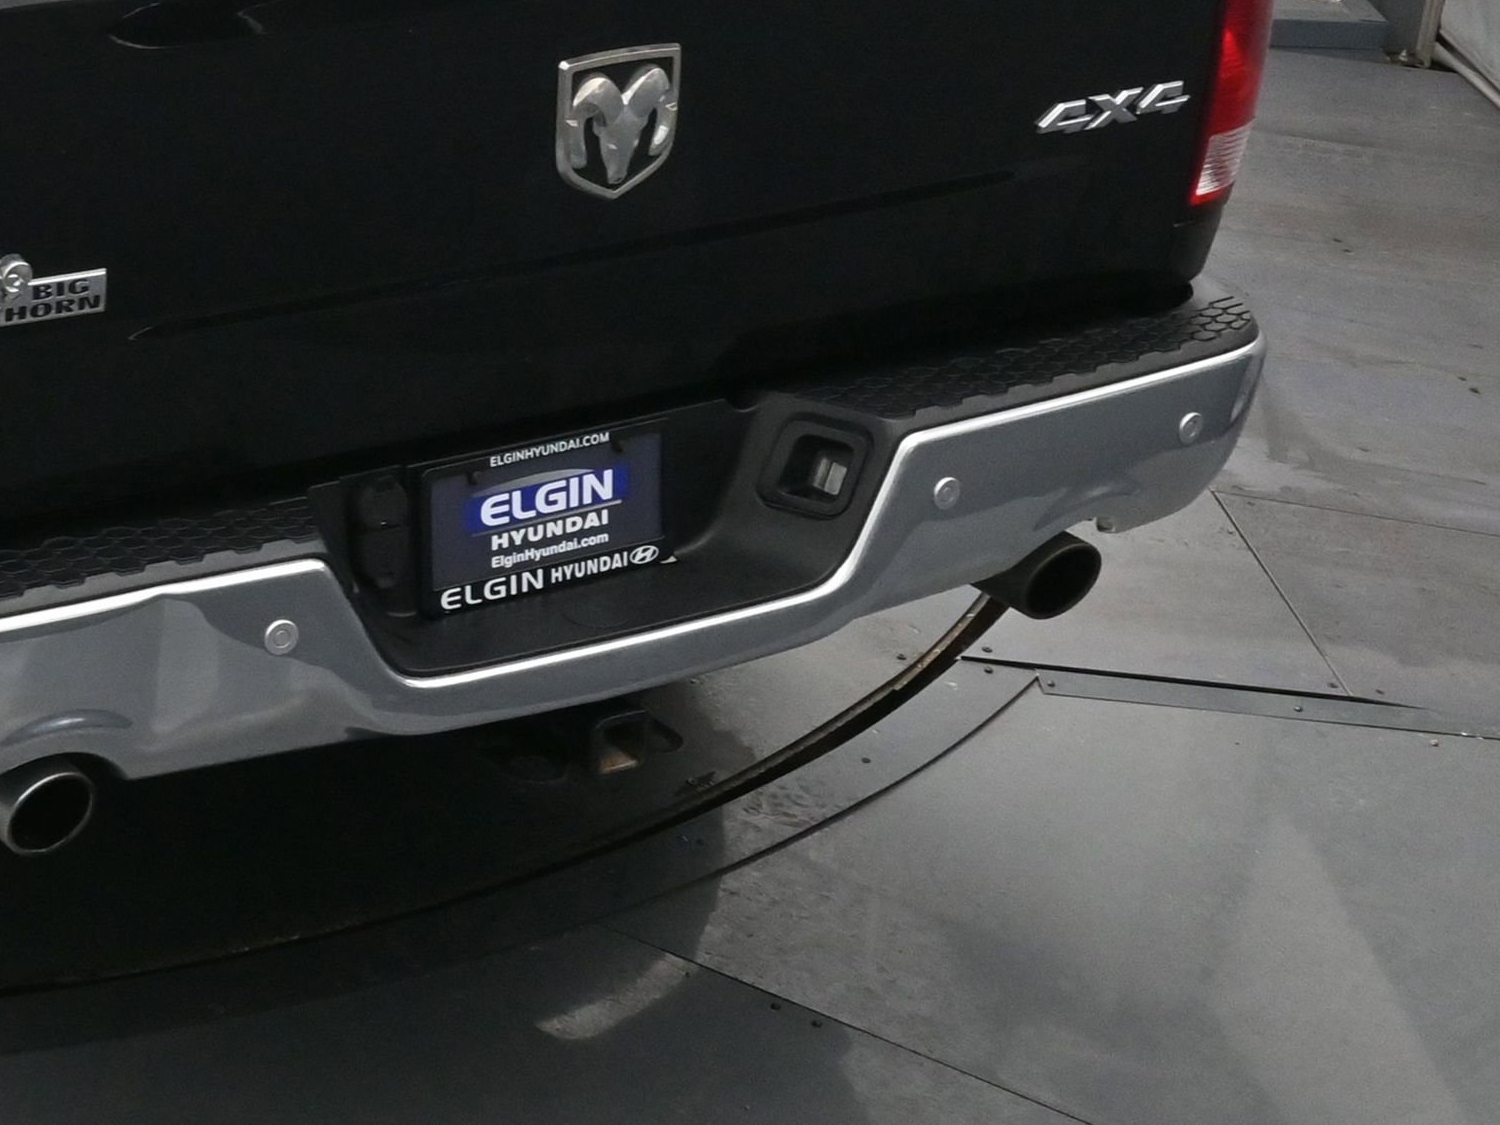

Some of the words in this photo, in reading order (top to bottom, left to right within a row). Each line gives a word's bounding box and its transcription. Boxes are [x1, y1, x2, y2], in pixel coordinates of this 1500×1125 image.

[32, 278, 90, 301] BIG
[4, 295, 101, 322] HORN
[490, 432, 610, 467] ELGINHYUNDAI.COM
[480, 469, 614, 527] ELGIN
[491, 509, 609, 551] HYUNDAI
[491, 532, 609, 569] ElginHyundai.com
[440, 569, 544, 611] ELGIN
[550, 551, 628, 584] HYUNDAI
